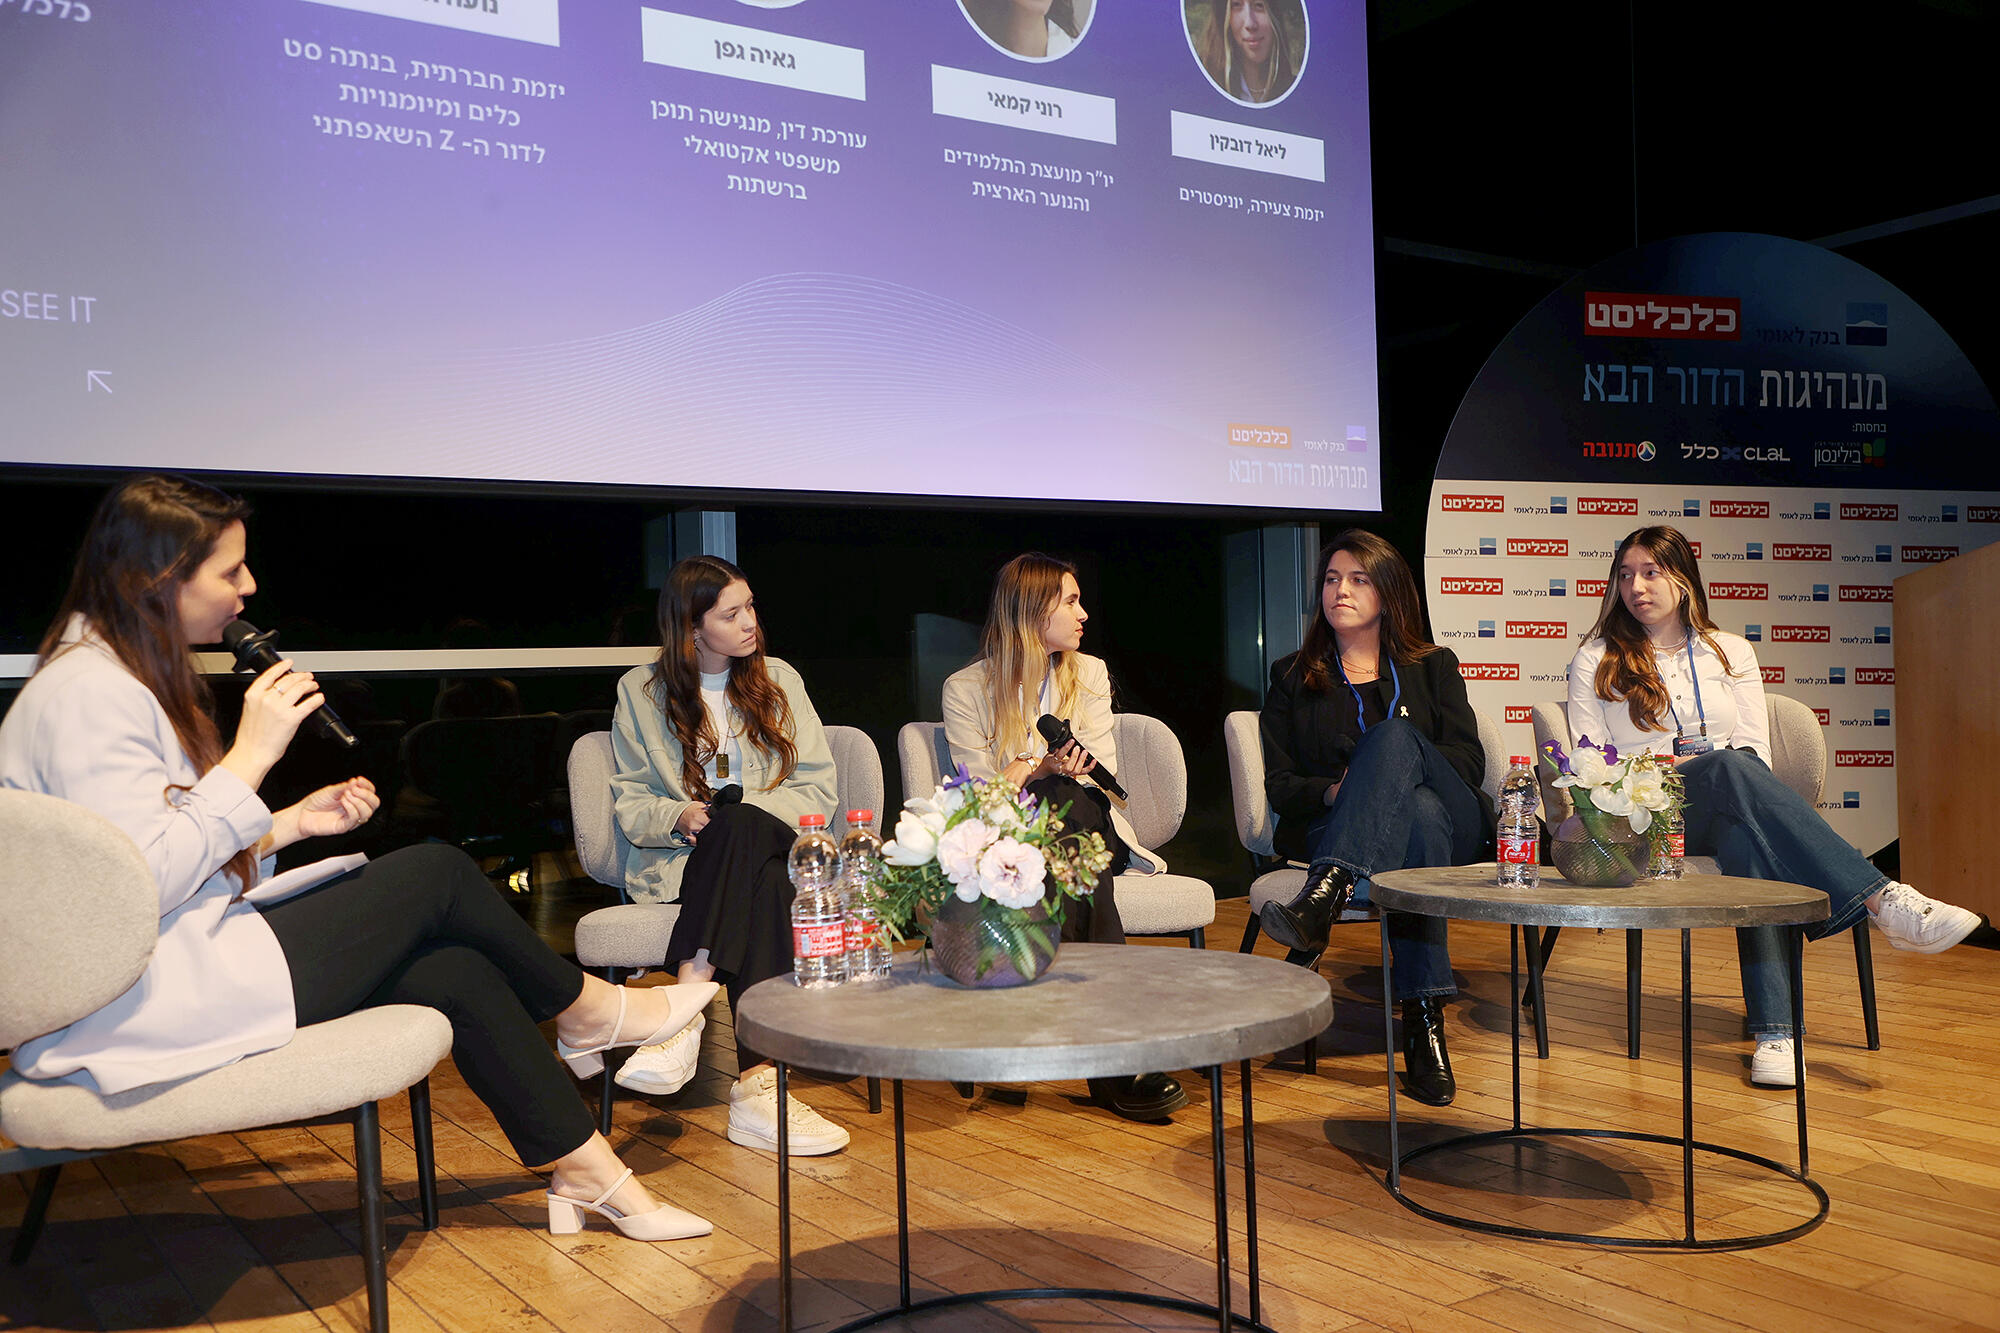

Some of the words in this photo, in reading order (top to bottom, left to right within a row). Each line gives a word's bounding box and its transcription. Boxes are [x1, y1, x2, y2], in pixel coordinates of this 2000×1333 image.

[284, 38, 322, 61] סט
[330, 46, 397, 73] בנתה
[714, 39, 745, 60] גפן
[750, 47, 796, 69] גאיה
[404, 60, 505, 91] חברתית,
[512, 76, 566, 99] יזמת
[339, 83, 461, 118] ומיומנויות
[651, 99, 693, 121] תוכן
[988, 91, 1031, 114] קמאי
[1035, 100, 1062, 118] רוני
[468, 103, 521, 127] כלים
[699, 108, 771, 133] מנגישה
[313, 114, 432, 148] השאפתני
[439, 129, 455, 151] Z
[777, 121, 806, 140] דין,
[812, 126, 867, 149] עורכת
[496, 140, 546, 164] לדור
[684, 135, 769, 164] אקטואלי
[1210, 133, 1252, 153] דובקין
[1255, 139, 1286, 159] ליאל
[775, 150, 841, 174] משפטי
[944, 148, 1026, 175] התלמידים
[1030, 162, 1082, 183] מועצת
[727, 174, 807, 200] ברשתות
[972, 181, 1036, 204] הארצית
[1040, 191, 1090, 212] והנוער
[1179, 187, 1243, 209] יוניסטרים
[1247, 199, 1291, 217] צעירה,
[1294, 205, 1324, 222] יזמת
[1, 289, 59, 320] SEE
[70, 295, 97, 323] IT
[1588, 301, 1737, 333] כלכליסט
[1754, 326, 1806, 344] לאומי
[1809, 329, 1841, 348] בנק
[1583, 363, 1654, 403] הבא
[1665, 366, 1745, 407] הדור
[1760, 368, 1888, 411] מנהיגות
[1231, 428, 1289, 445] כלכליסט
[1303, 439, 1327, 451] לאומי
[1329, 441, 1345, 453] בנק
[1583, 442, 1638, 459] תנובה
[1680, 442, 1720, 460] כלל
[1814, 446, 1862, 468] בילינסון
[1228, 459, 1263, 484] הבא
[1267, 461, 1305, 487] הדור
[1310, 463, 1368, 489] מנהיגות
[1443, 497, 1503, 510] כלכליסט
[1578, 499, 1637, 513] כלכליסט
[1711, 503, 1768, 516] כלכליסט
[1841, 505, 1897, 519] כלכליסט
[1969, 509, 2000, 520] ליסט
[1508, 541, 1567, 554] כלכליסט
[1773, 546, 1830, 559] כלכליסט
[1442, 579, 1502, 593] כלכליסט
[1710, 585, 1767, 598] כלכליסט
[1506, 623, 1566, 636] כלכליסט
[1772, 628, 1829, 640] כלכליסט
[1459, 665, 1518, 678] כלכליסט
[1856, 671, 1895, 682] כליסט
[1836, 752, 1893, 764] כלכליסט
[1816, 801, 1828, 809] לאו
